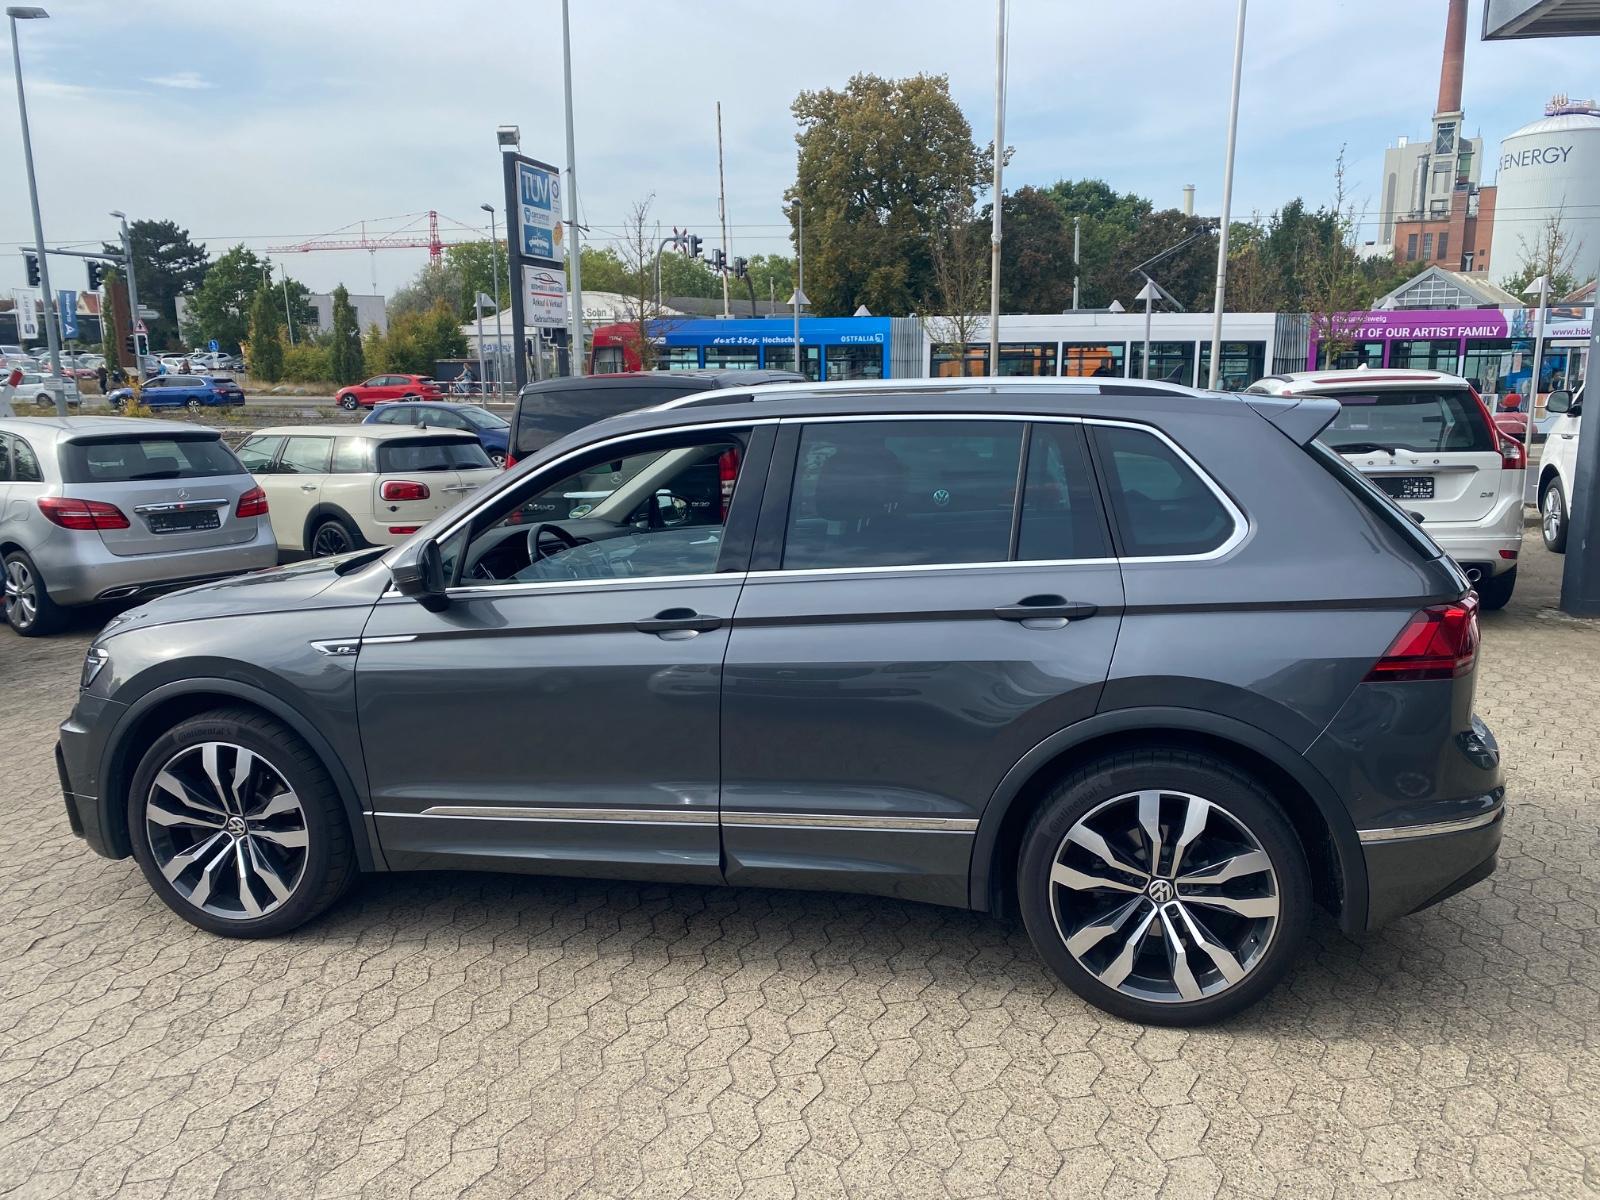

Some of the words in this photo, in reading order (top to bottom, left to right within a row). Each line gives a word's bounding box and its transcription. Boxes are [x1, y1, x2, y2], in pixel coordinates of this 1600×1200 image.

[521, 170, 548, 204] TÜV
[586, 307, 607, 317] Sohn
[1367, 328, 1384, 338] OF
[1385, 327, 1410, 338] OUR
[1412, 327, 1456, 337] ARTIST
[1457, 326, 1500, 336] FAMILY
[762, 336, 805, 344] Hochschue
[840, 335, 875, 343] OSTFALIA
